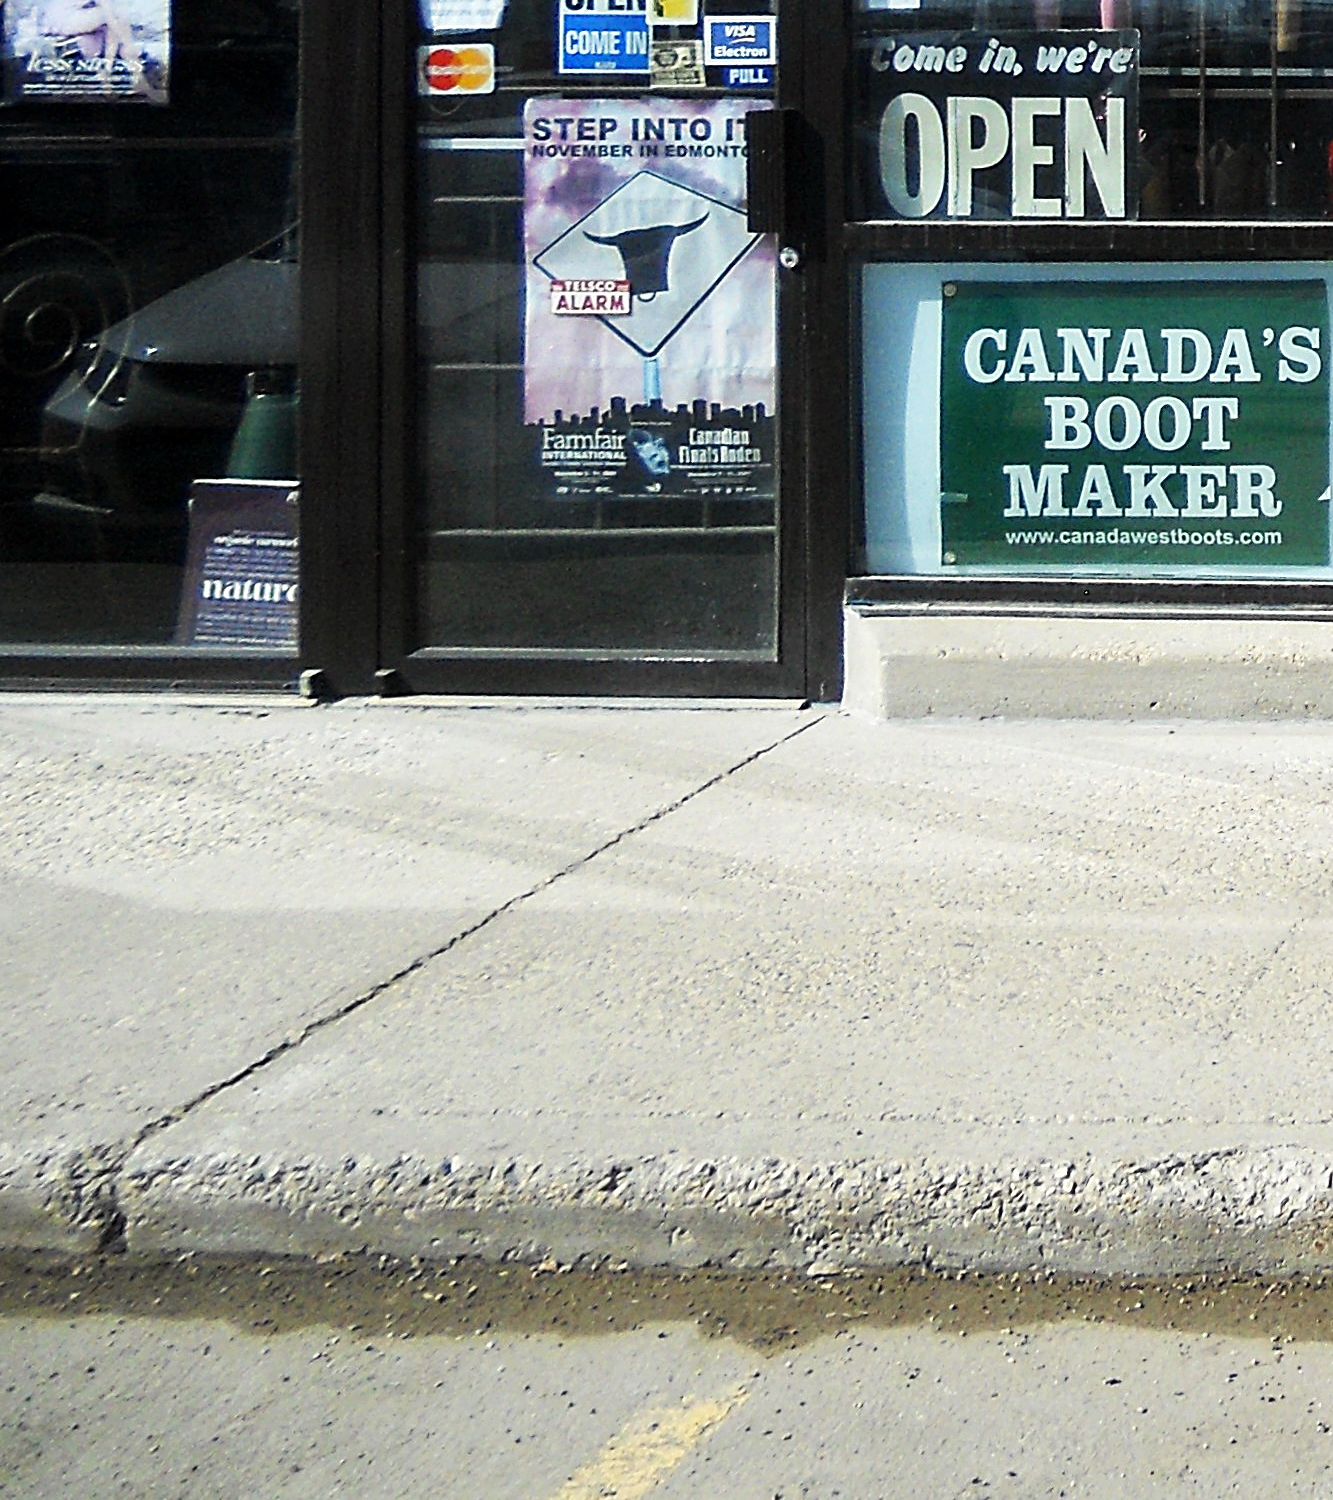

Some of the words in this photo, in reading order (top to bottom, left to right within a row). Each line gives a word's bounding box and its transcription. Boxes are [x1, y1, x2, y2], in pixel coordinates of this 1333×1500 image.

[724, 25, 756, 38] VISA
[565, 30, 621, 56] COME
[626, 31, 648, 55] IN
[713, 44, 768, 59] Electron
[871, 38, 968, 73] Come
[978, 37, 1024, 76] in,
[1036, 39, 1133, 73] we're
[728, 68, 769, 84] PULL
[531, 117, 618, 142] STEP
[631, 117, 711, 142] INTO
[531, 144, 633, 159] NOVEMBER
[639, 144, 658, 159] IN
[664, 144, 749, 159] EDMONTO
[878, 91, 1126, 219] OPEN
[563, 280, 618, 292] TELSCO
[555, 294, 626, 312] ALARM
[963, 326, 1323, 384] CANADA'S
[1043, 395, 1239, 451] BOOT
[542, 427, 627, 451] Farmfair
[541, 450, 628, 461] INTERNATIONAL
[1002, 463, 1284, 518] MAKER
[1005, 528, 1283, 546] www.canadawestboots.com
